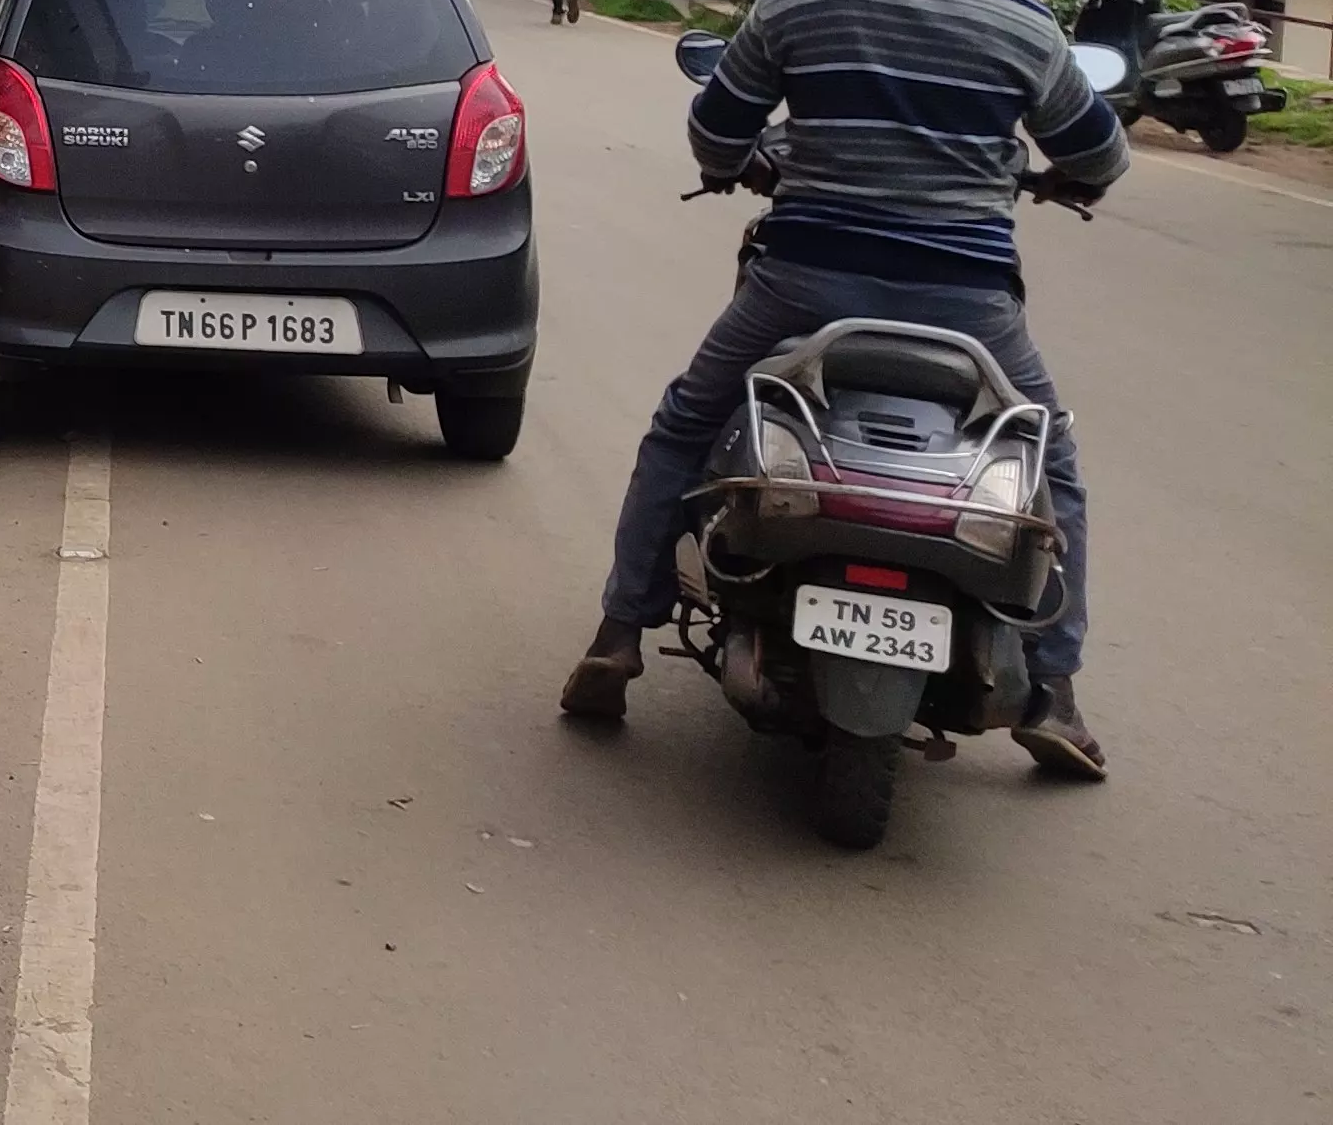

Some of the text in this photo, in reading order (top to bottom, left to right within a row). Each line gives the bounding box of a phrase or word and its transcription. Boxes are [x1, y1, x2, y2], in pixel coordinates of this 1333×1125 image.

[63, 126, 129, 136] MARUTI
[384, 128, 439, 141] ALTO
[63, 135, 129, 146] SUZUKI
[833, 600, 915, 632] TN 59
[809, 626, 935, 663] AW 2343
